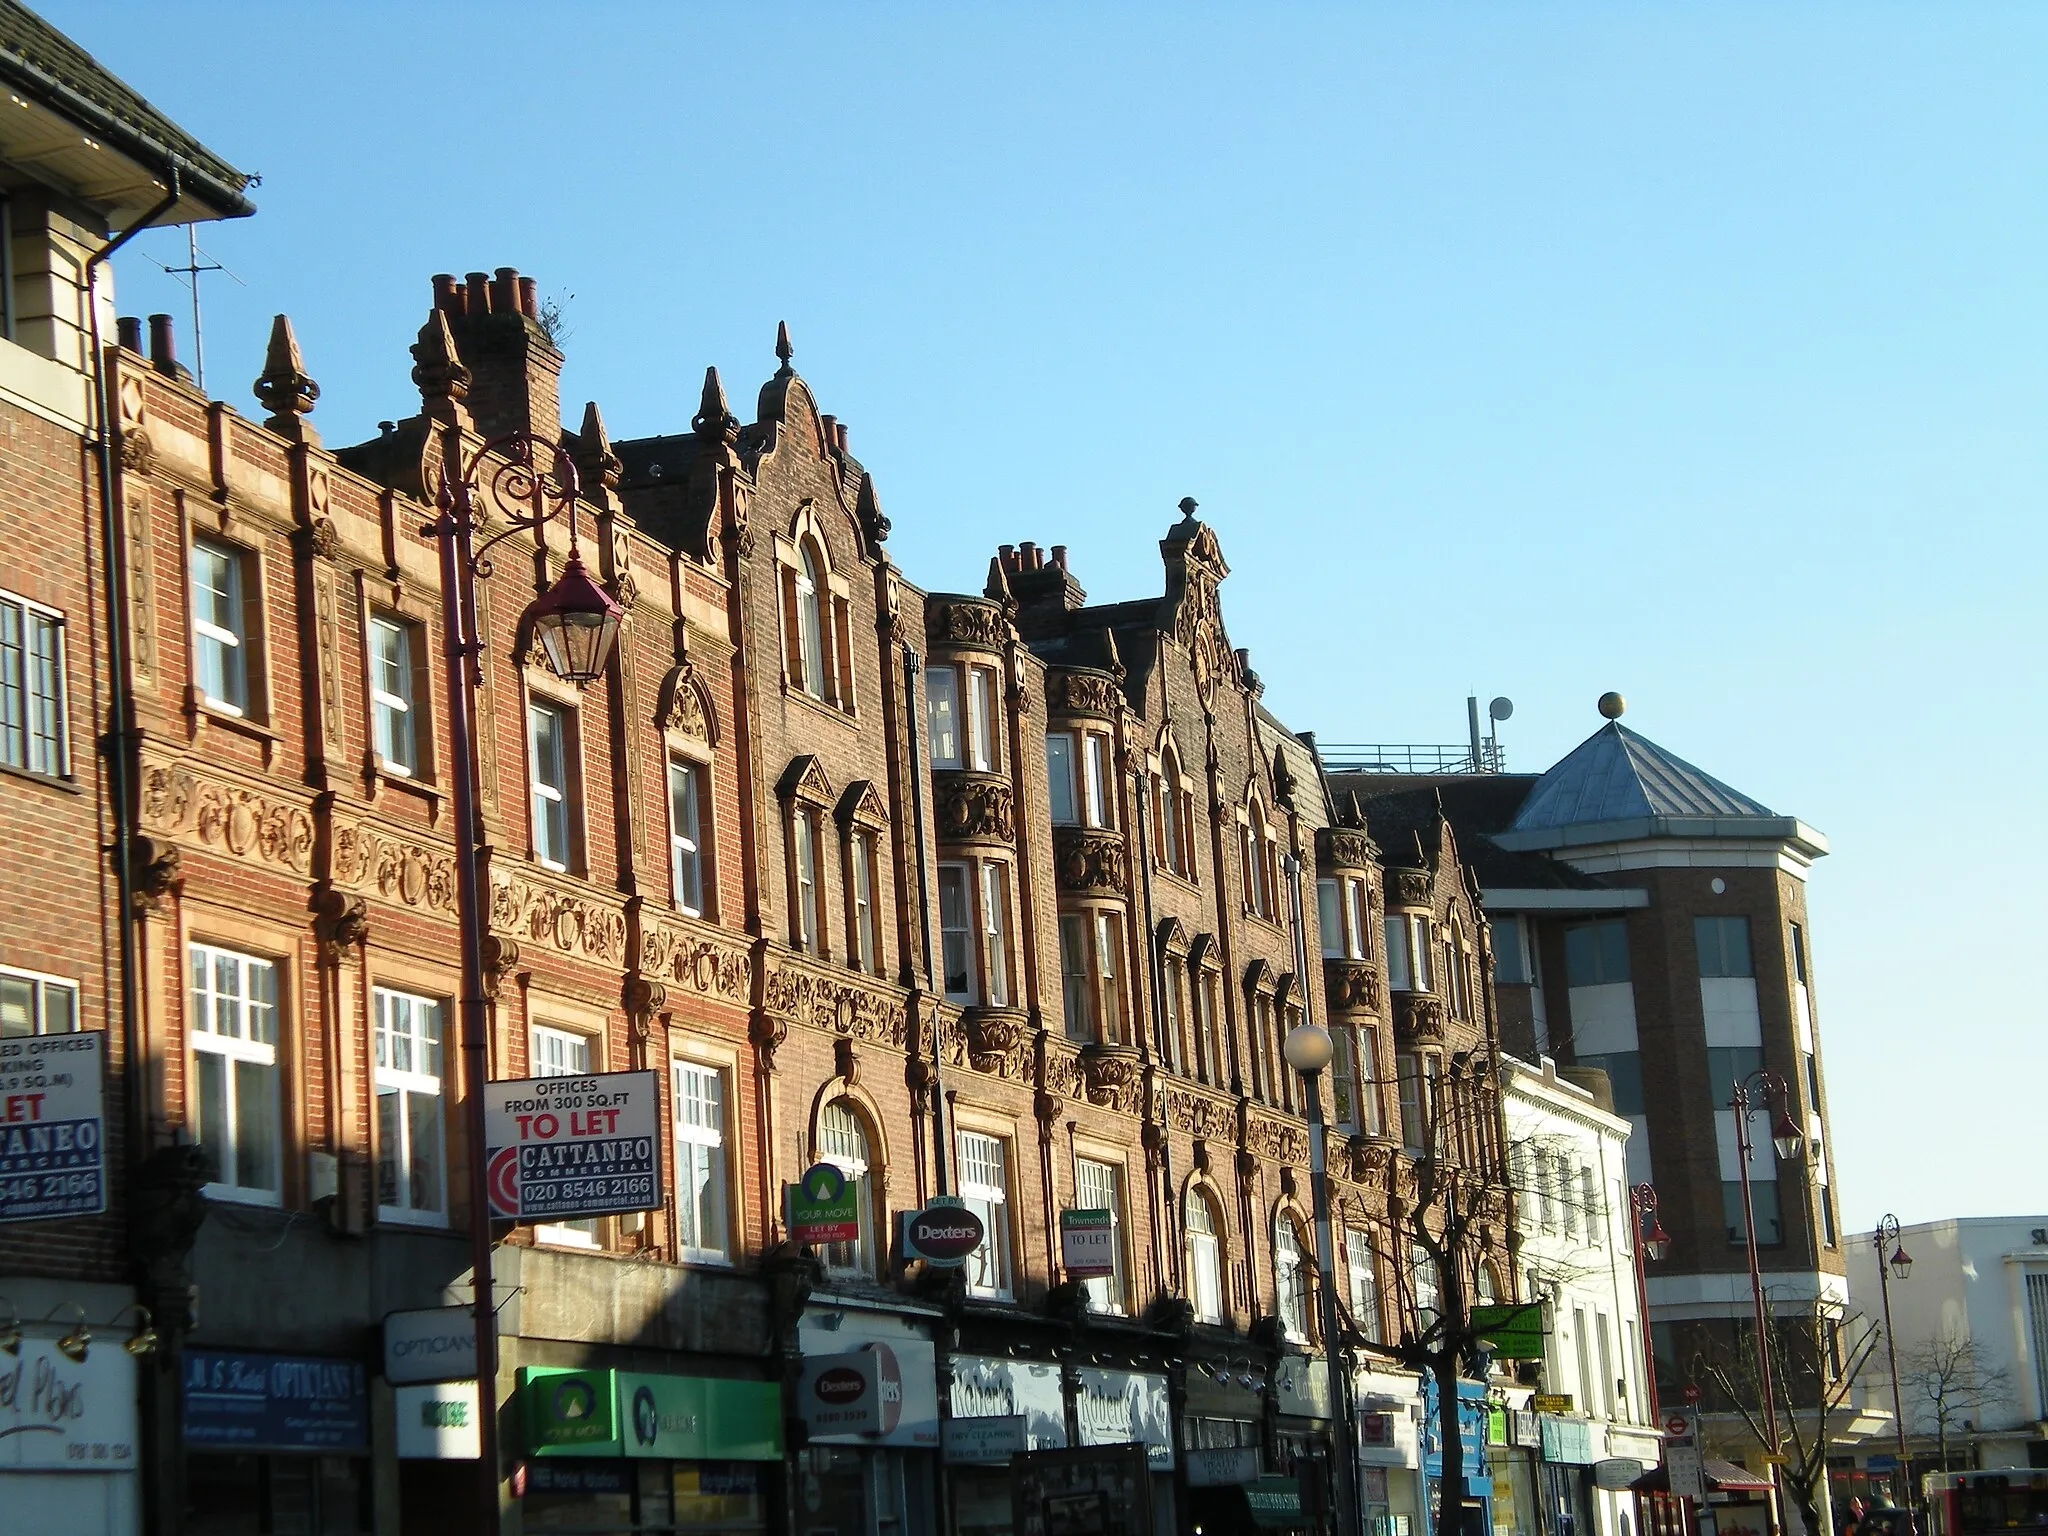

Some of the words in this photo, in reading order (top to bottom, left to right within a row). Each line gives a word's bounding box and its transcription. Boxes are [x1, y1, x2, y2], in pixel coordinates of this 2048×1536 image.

[28, 1037, 95, 1055] OFFICES
[535, 1080, 598, 1096] OFFICES
[0, 1093, 46, 1122] ET
[504, 1098, 549, 1113] FROM
[554, 1096, 583, 1110] 300
[586, 1092, 629, 1108] SQ.FT
[515, 1113, 560, 1141] TO
[570, 1109, 620, 1137] LET
[521, 1138, 650, 1169] CATTANEO
[523, 1163, 651, 1179] COMMERCIAL
[42, 1172, 98, 1197] 2166
[523, 1184, 557, 1201] 020
[562, 1180, 607, 1199] 8546
[611, 1177, 651, 1195] 2166
[948, 1197, 958, 1205] BY
[796, 1209, 822, 1220] YOUR
[824, 1207, 853, 1218] MOVE
[1068, 1215, 1109, 1225] Townends
[810, 1225, 825, 1233] LET
[827, 1224, 839, 1232] BY
[918, 1224, 976, 1240] Dexters
[1072, 1234, 1085, 1245] TO
[1089, 1234, 1108, 1245] LET
[820, 1380, 862, 1393] Dexters
